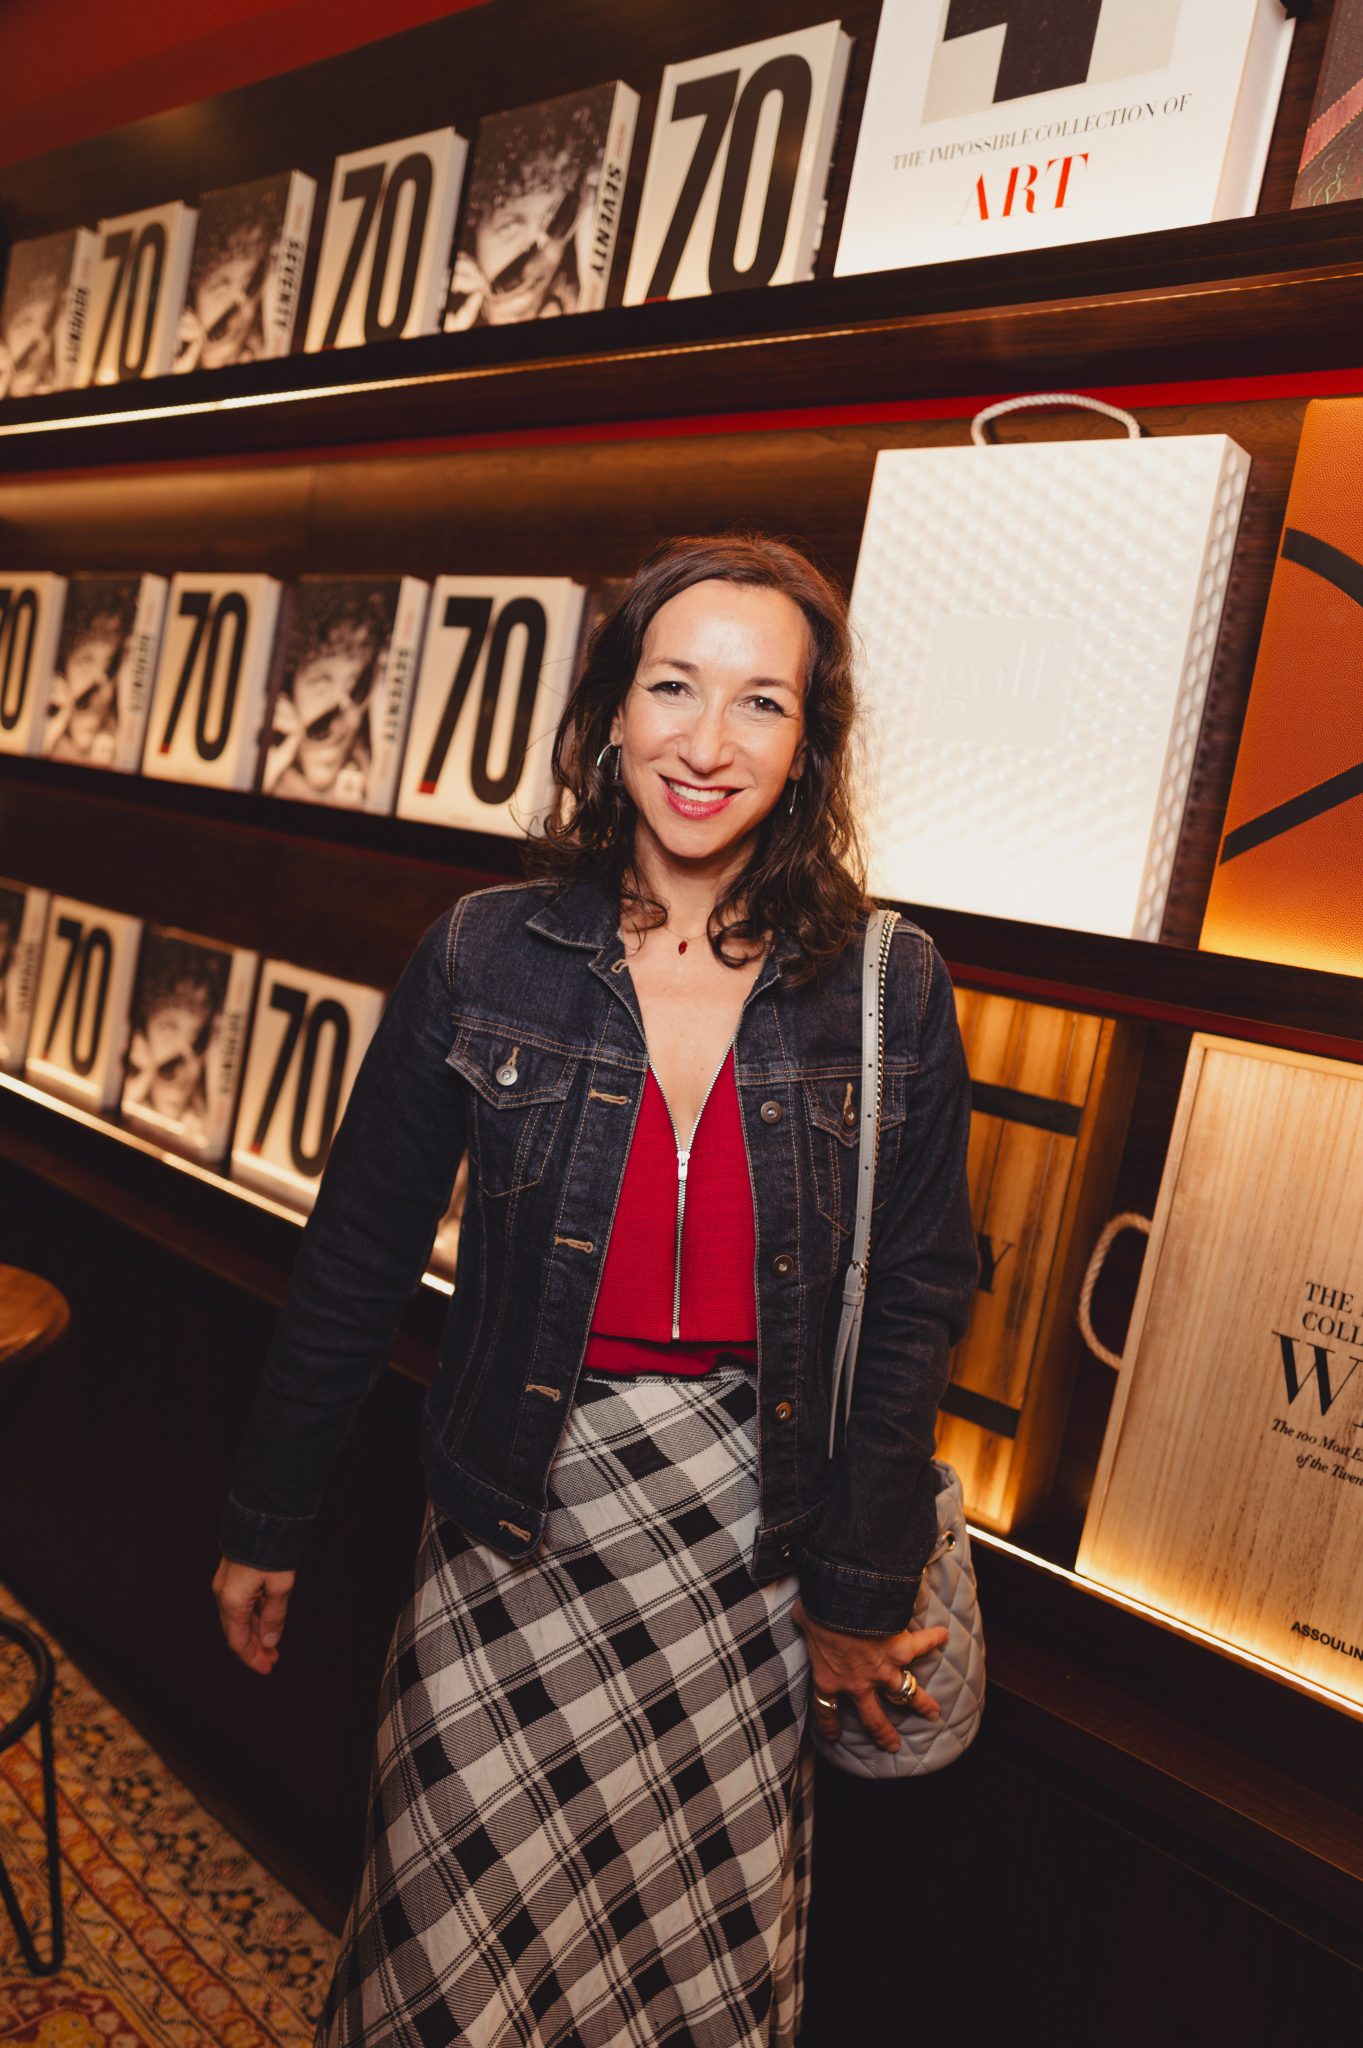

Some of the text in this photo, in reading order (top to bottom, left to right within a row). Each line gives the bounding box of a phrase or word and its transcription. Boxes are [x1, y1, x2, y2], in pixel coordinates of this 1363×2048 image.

[644, 54, 812, 303] 70
[892, 93, 1192, 171] THE IMPOSSIBLE COLLECTION OF
[591, 164, 622, 277] SEVENTY
[954, 152, 1089, 226] ART
[89, 222, 167, 387] 70
[322, 153, 433, 349] 70
[0, 589, 38, 730] 0
[159, 592, 248, 761] 70
[417, 596, 547, 805] 70
[42, 917, 112, 1076] 70
[249, 983, 351, 1178] 70
[1302, 1311, 1363, 1347] COLL
[1305, 1281, 1354, 1314] THE
[1271, 1330, 1363, 1428] W
[1272, 1418, 1295, 1437] The
[1318, 1436, 1351, 1457] Most
[1296, 1454, 1312, 1469] of
[1309, 1457, 1329, 1473] the
[1291, 1621, 1363, 1662] ASSOULIN
